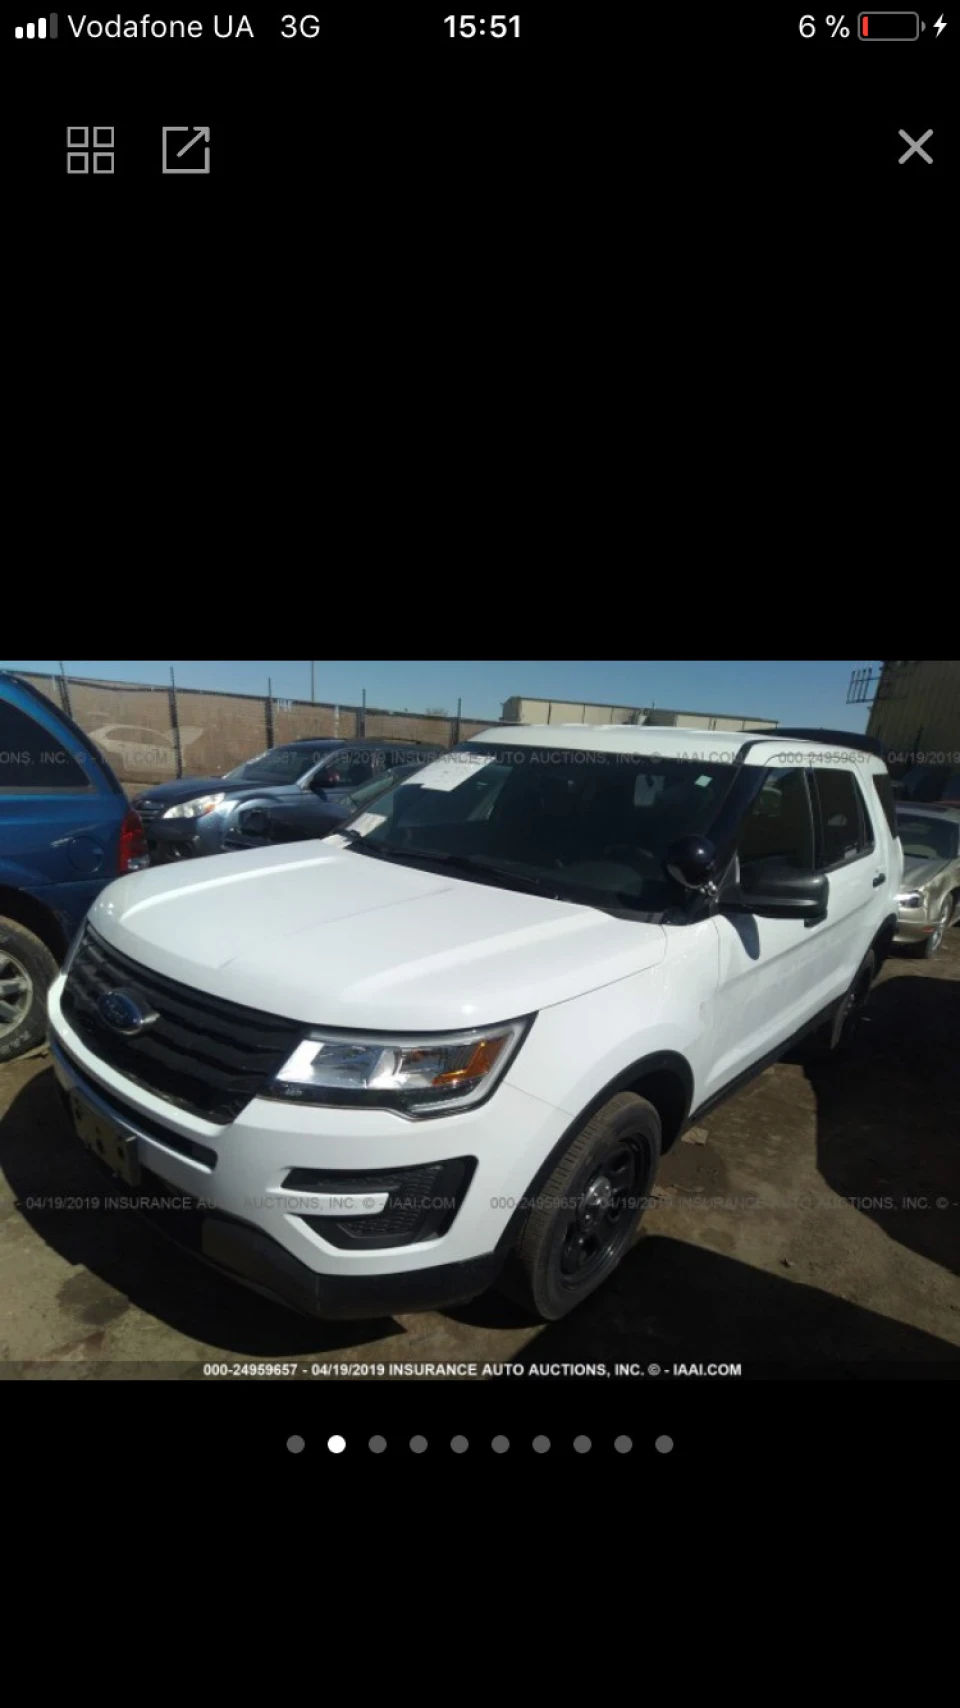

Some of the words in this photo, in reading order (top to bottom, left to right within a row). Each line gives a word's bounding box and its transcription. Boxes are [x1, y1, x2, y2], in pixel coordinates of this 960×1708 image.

[68, 13, 203, 38] Vodafone
[214, 14, 255, 38] UA
[280, 14, 321, 38] 3G
[443, 14, 521, 38] 15:51
[798, 14, 816, 38] 6
[825, 14, 851, 38] %
